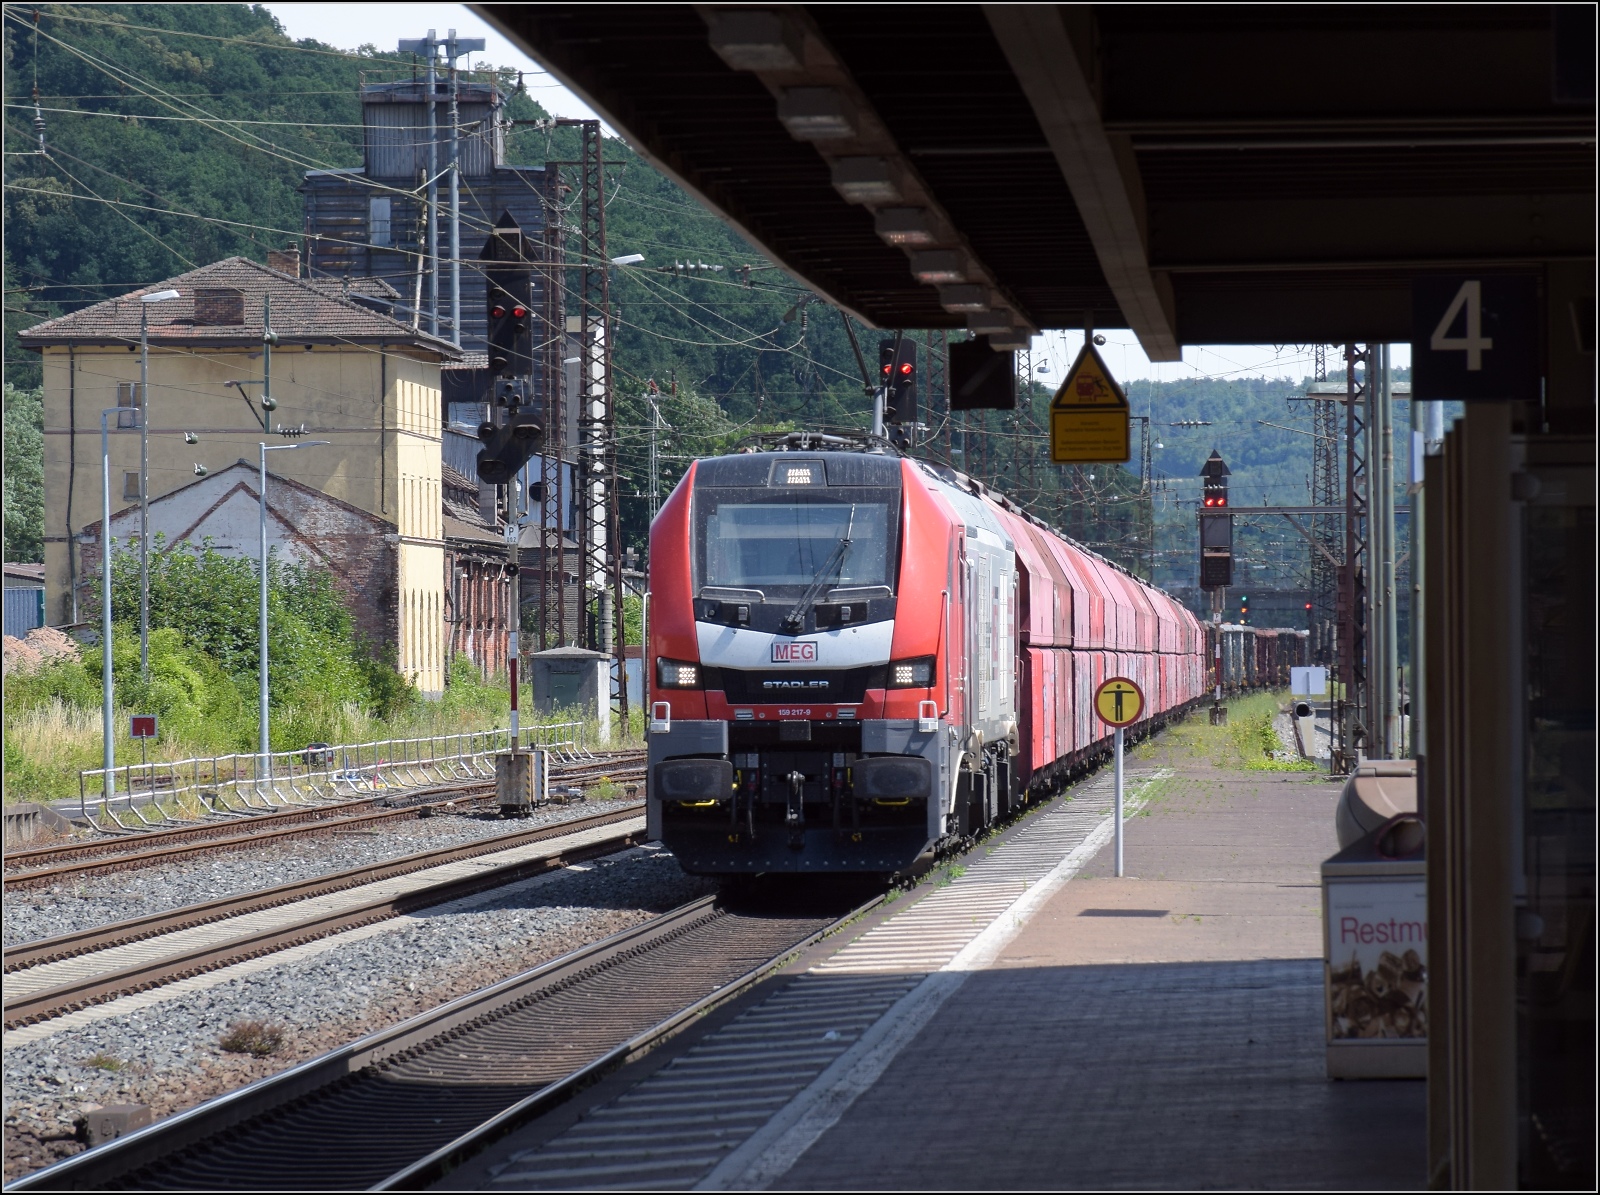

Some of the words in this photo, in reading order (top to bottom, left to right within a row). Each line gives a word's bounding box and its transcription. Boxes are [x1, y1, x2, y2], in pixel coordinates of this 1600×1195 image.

[1430, 280, 1493, 371] 4
[509, 526, 514, 536] P
[775, 644, 814, 660] MEG
[763, 681, 829, 689] STADLER
